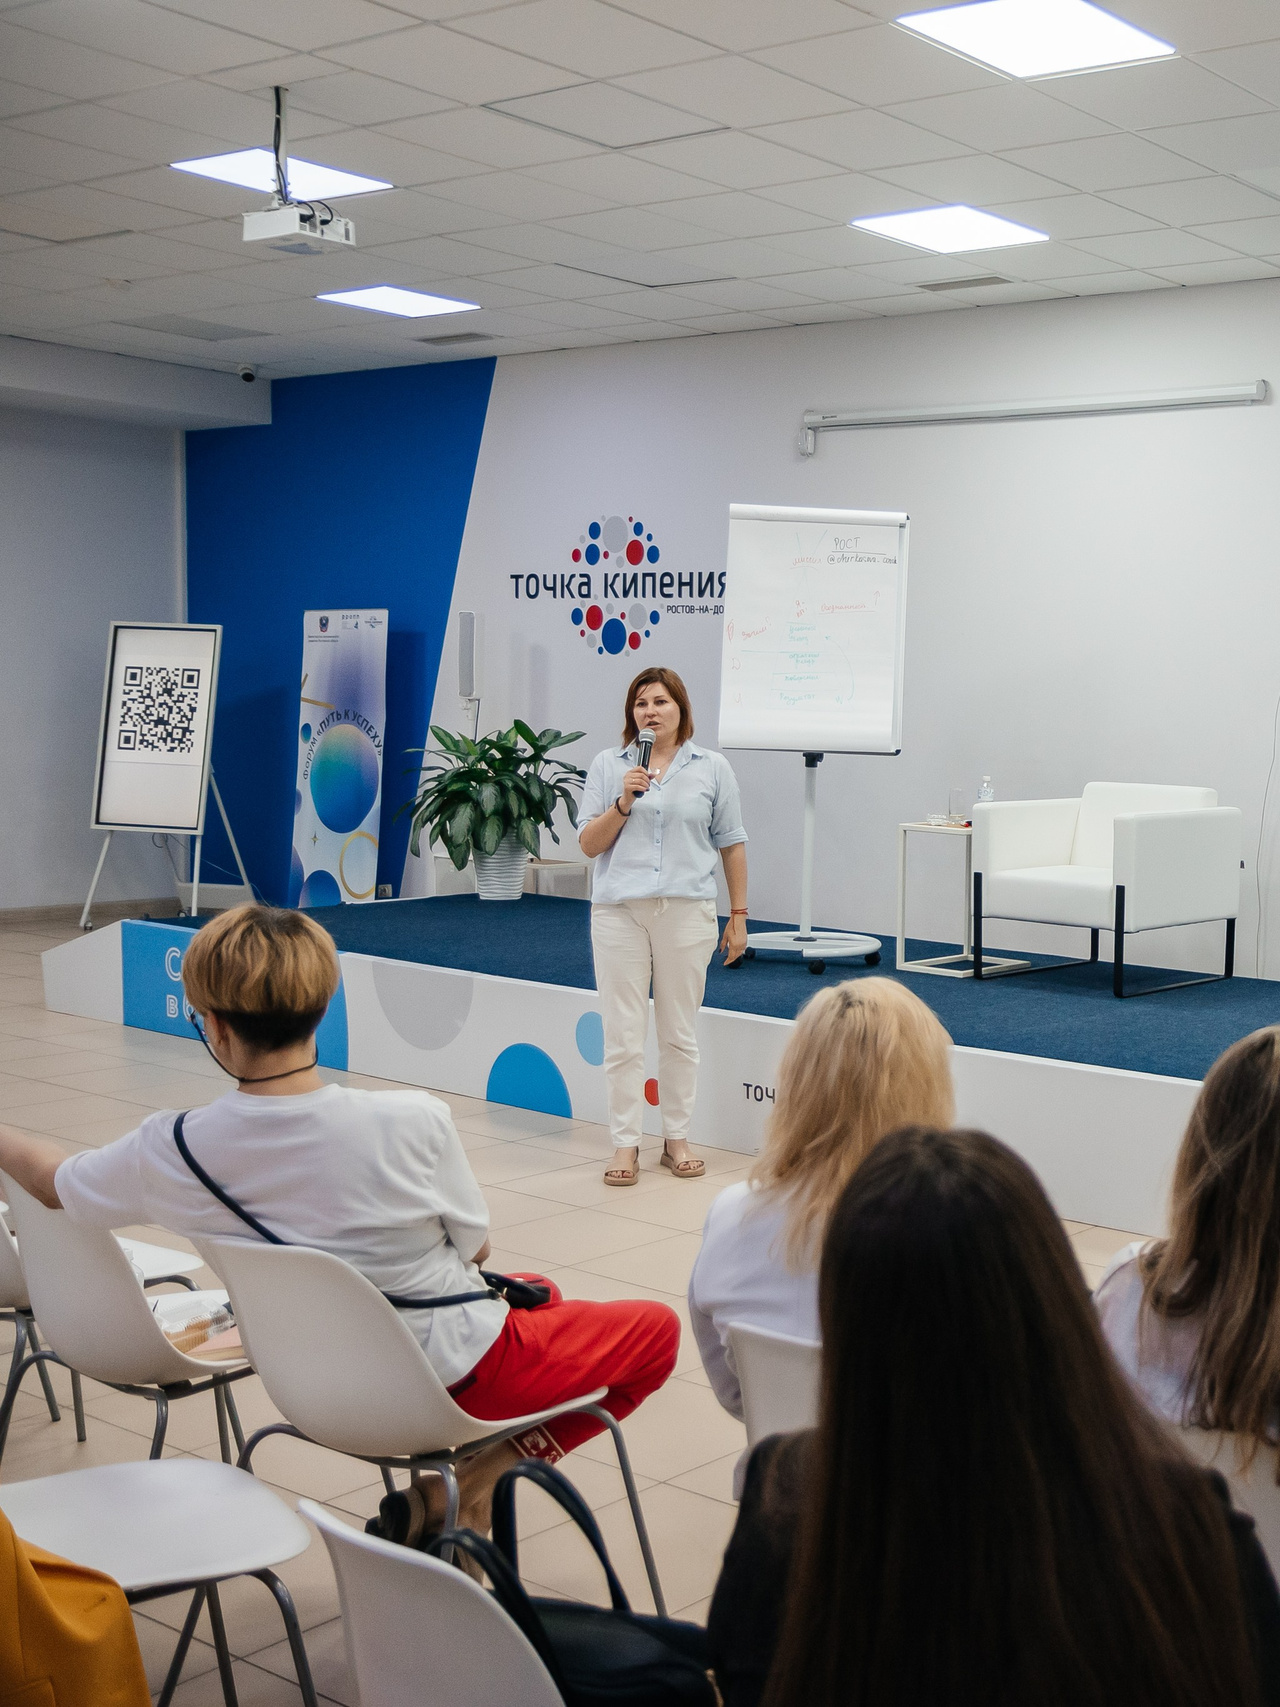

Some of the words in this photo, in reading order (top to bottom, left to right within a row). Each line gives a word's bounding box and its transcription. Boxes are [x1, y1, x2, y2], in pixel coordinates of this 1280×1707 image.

[834, 536, 860, 550] РОСТ
[510, 573, 592, 599] точка
[666, 604, 725, 615] РОСТОВ-НА-ДО
[303, 737, 318, 780] Форум
[316, 710, 342, 736] «ПУТЬ
[344, 709, 351, 720] К
[743, 1082, 776, 1104] точ
